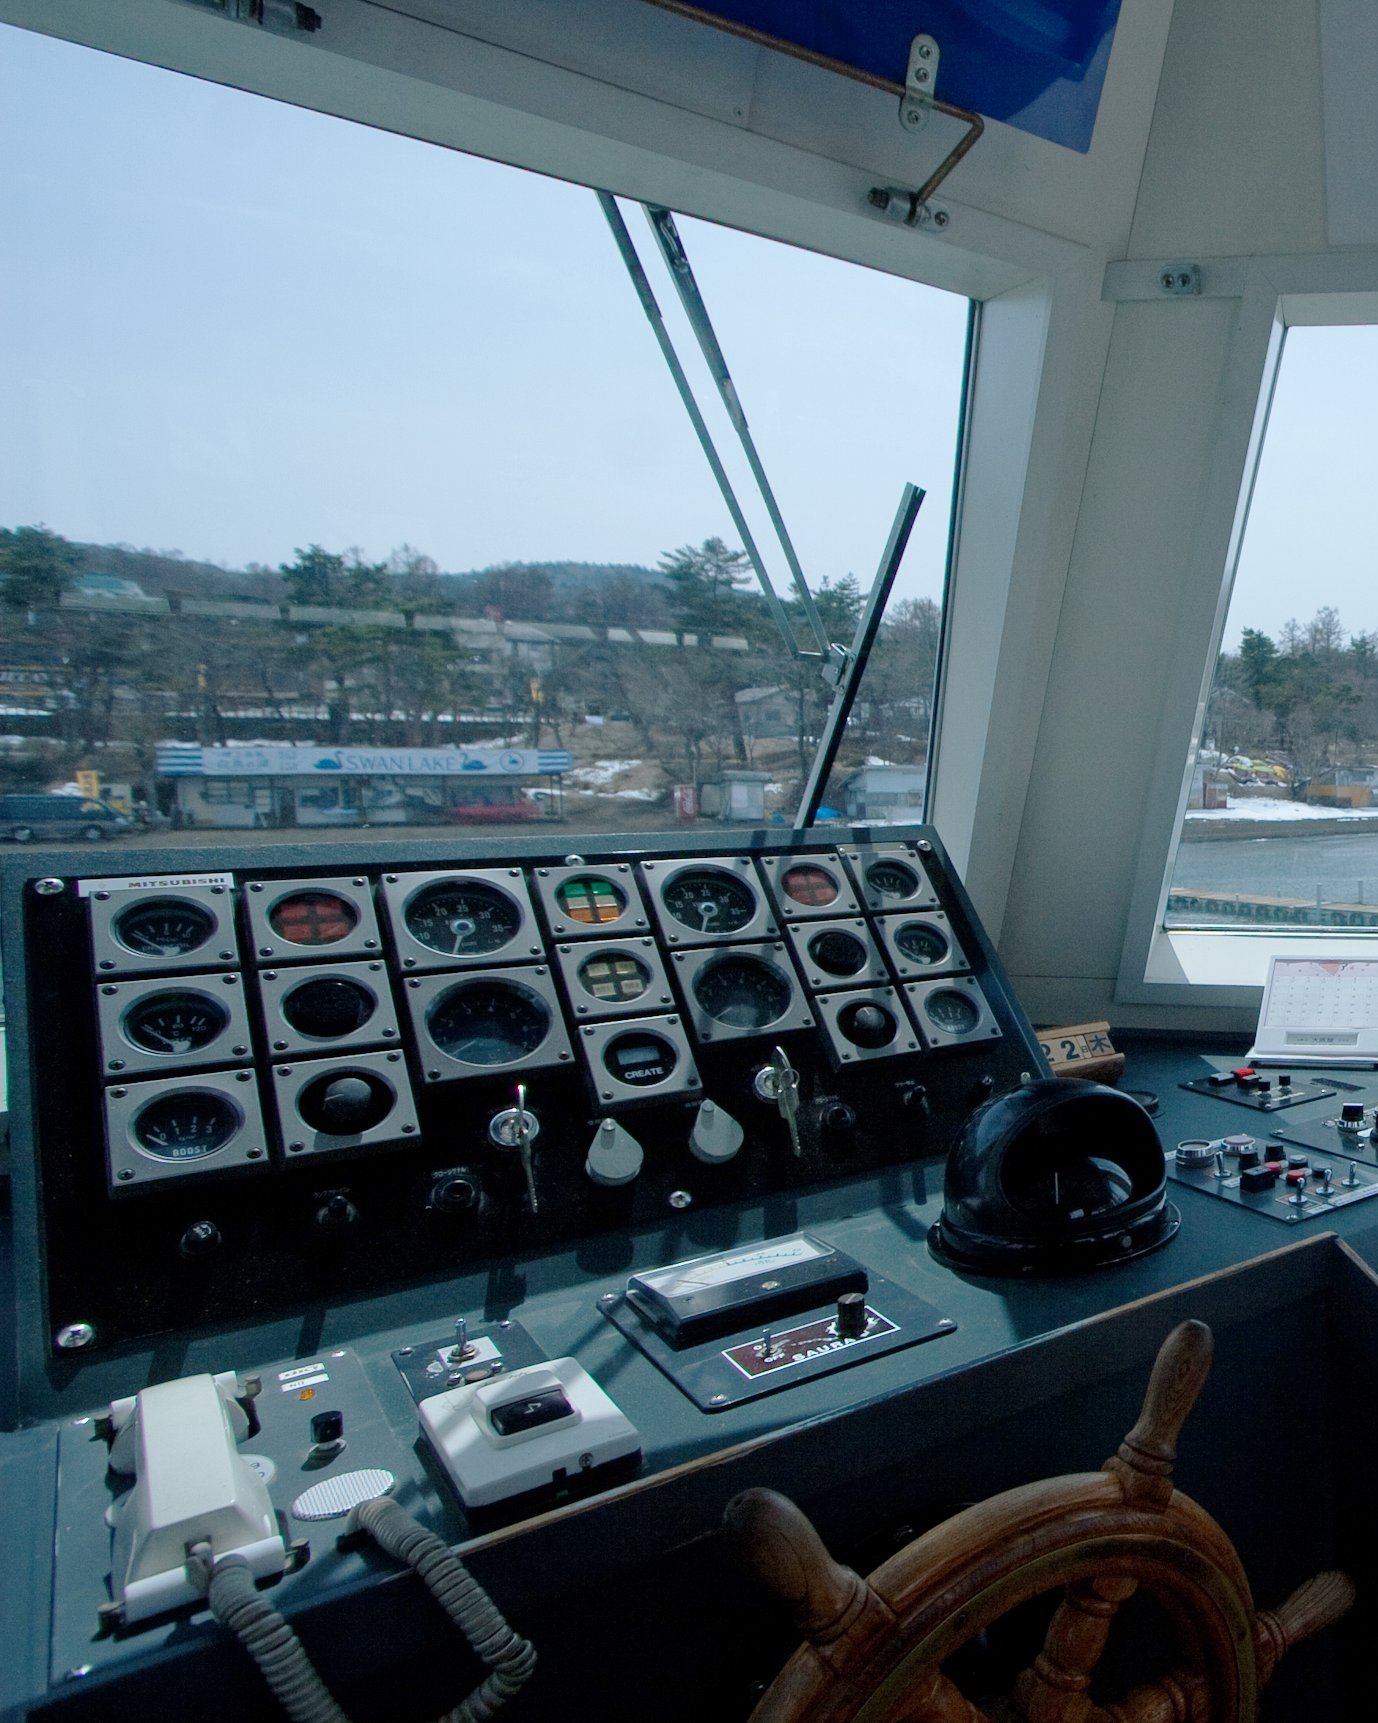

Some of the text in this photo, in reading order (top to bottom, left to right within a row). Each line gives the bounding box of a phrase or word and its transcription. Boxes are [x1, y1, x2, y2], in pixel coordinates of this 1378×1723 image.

[346, 753, 457, 771] SWAN LAKE
[128, 878, 225, 889] MITSUBISHI
[435, 908, 448, 916] 20
[456, 904, 469, 913] 25
[478, 911, 491, 920] 30
[422, 919, 434, 928] 15
[491, 924, 504, 933] 35
[419, 932, 431, 941] 10
[1089, 1034, 1112, 1053] 木
[624, 1066, 665, 1080] CREATE
[190, 1125, 198, 1133] 2
[205, 1125, 213, 1134] 3
[159, 1133, 167, 1141] 0
[172, 1145, 208, 1157] BOOST
[791, 1336, 857, 1362] SAURA
[763, 1352, 785, 1364] OFF
